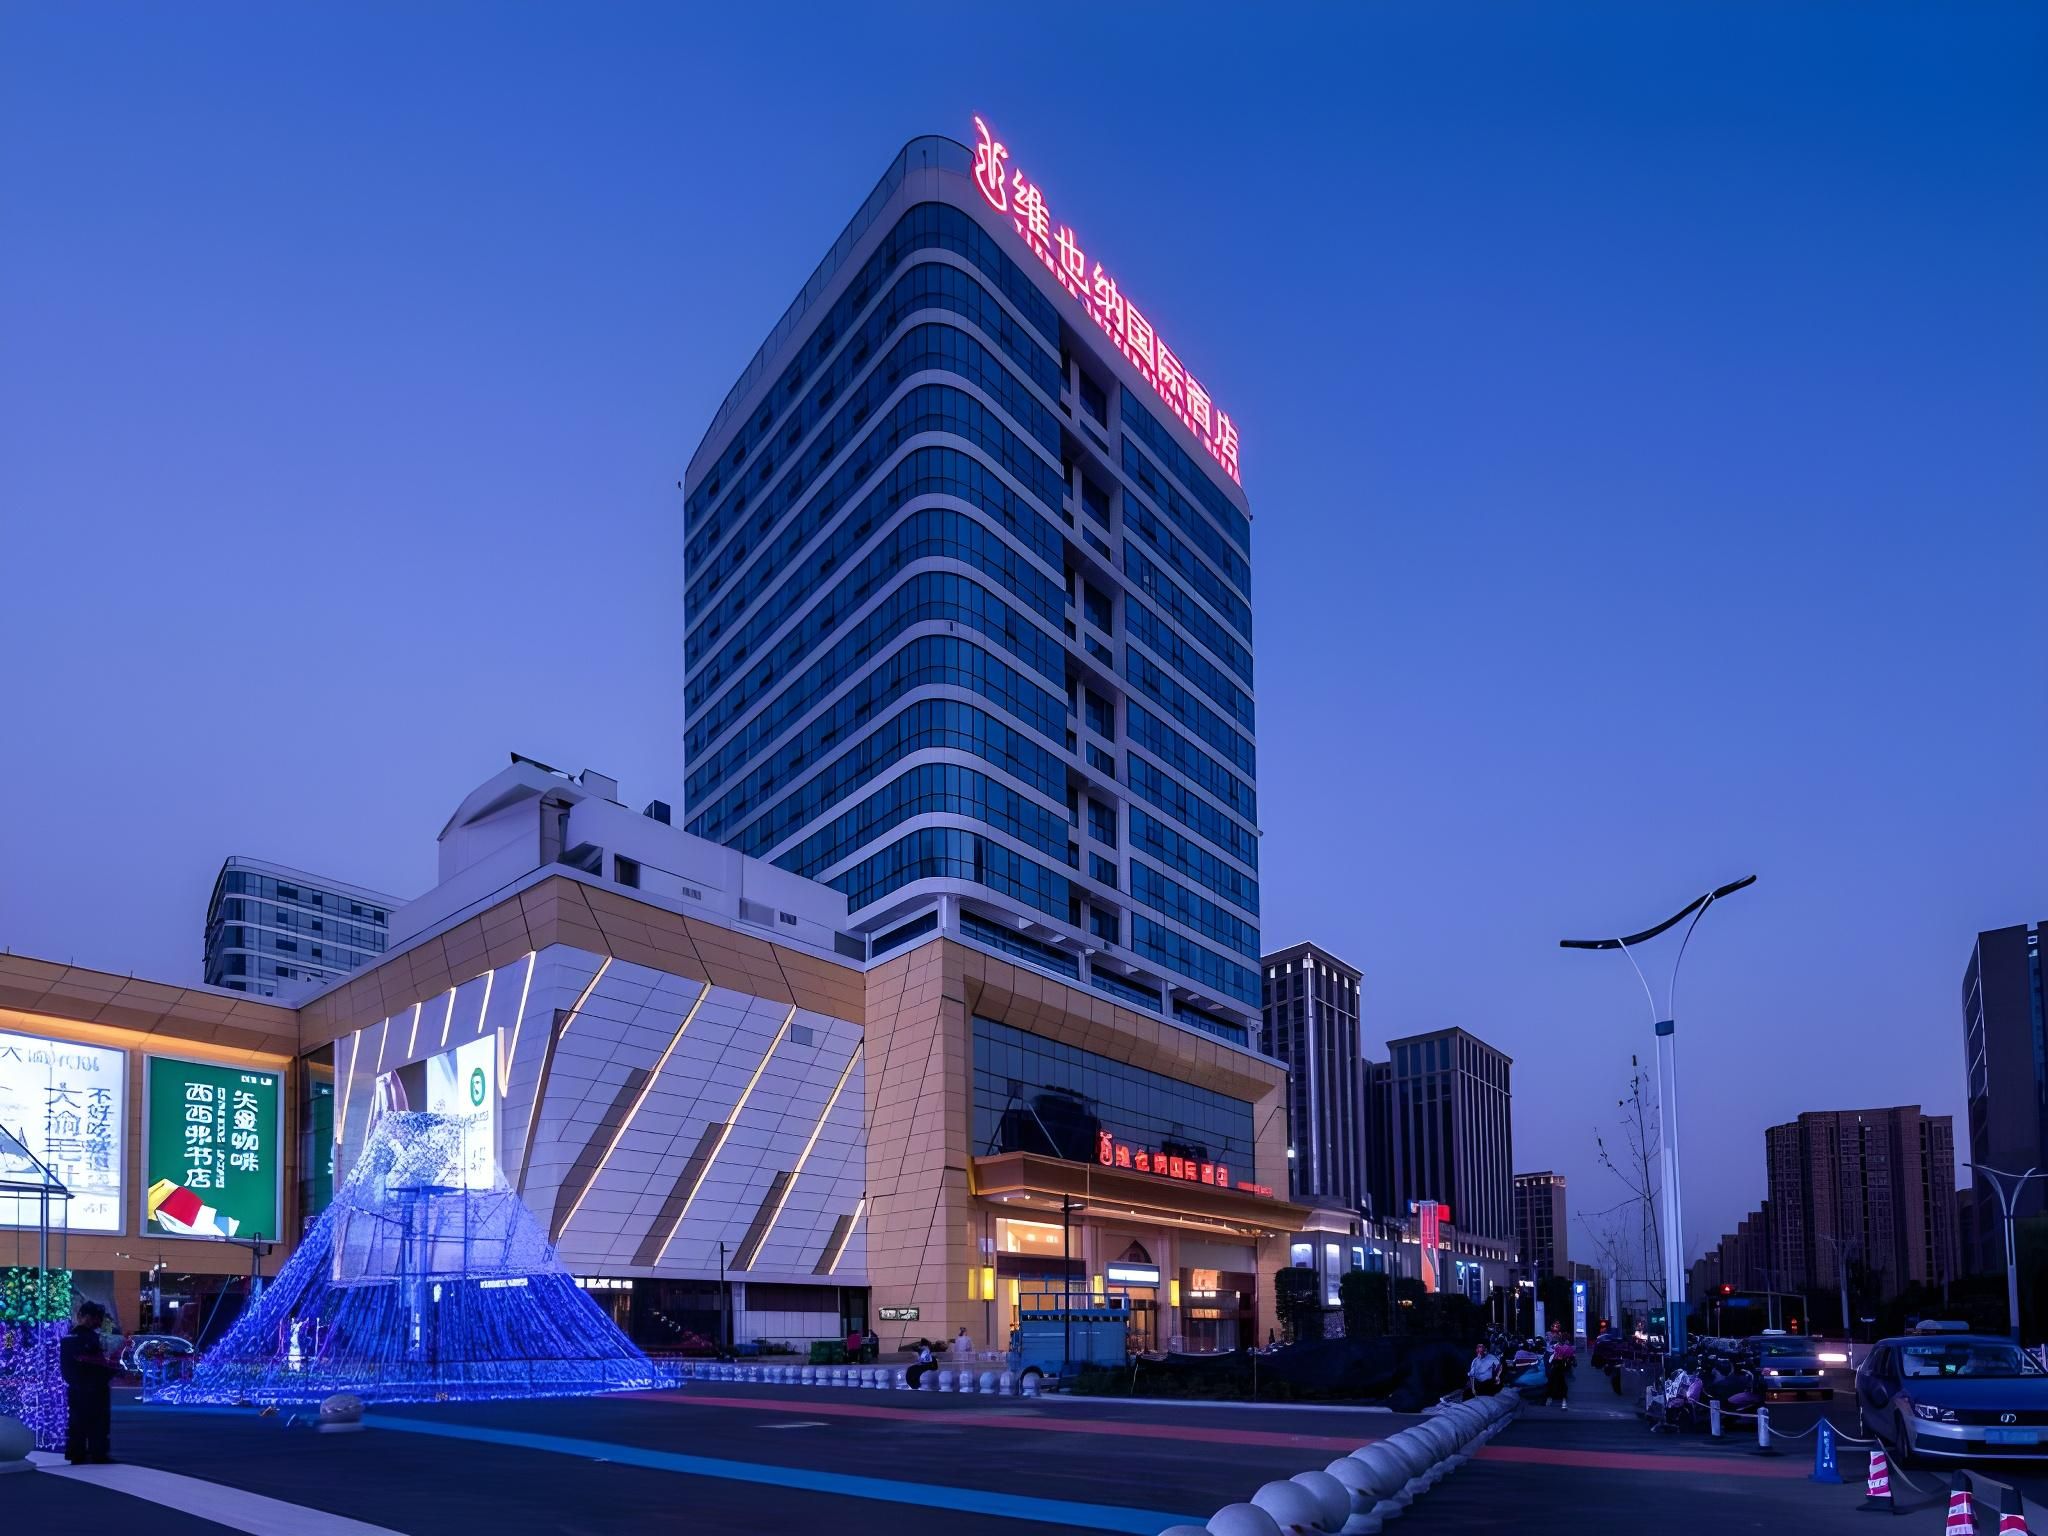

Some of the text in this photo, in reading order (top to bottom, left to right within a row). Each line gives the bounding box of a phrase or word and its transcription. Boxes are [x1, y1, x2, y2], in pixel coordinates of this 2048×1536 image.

[1013, 168, 1239, 466] 维也纳国际酒店
[183, 1082, 213, 1188] 西西弗书店
